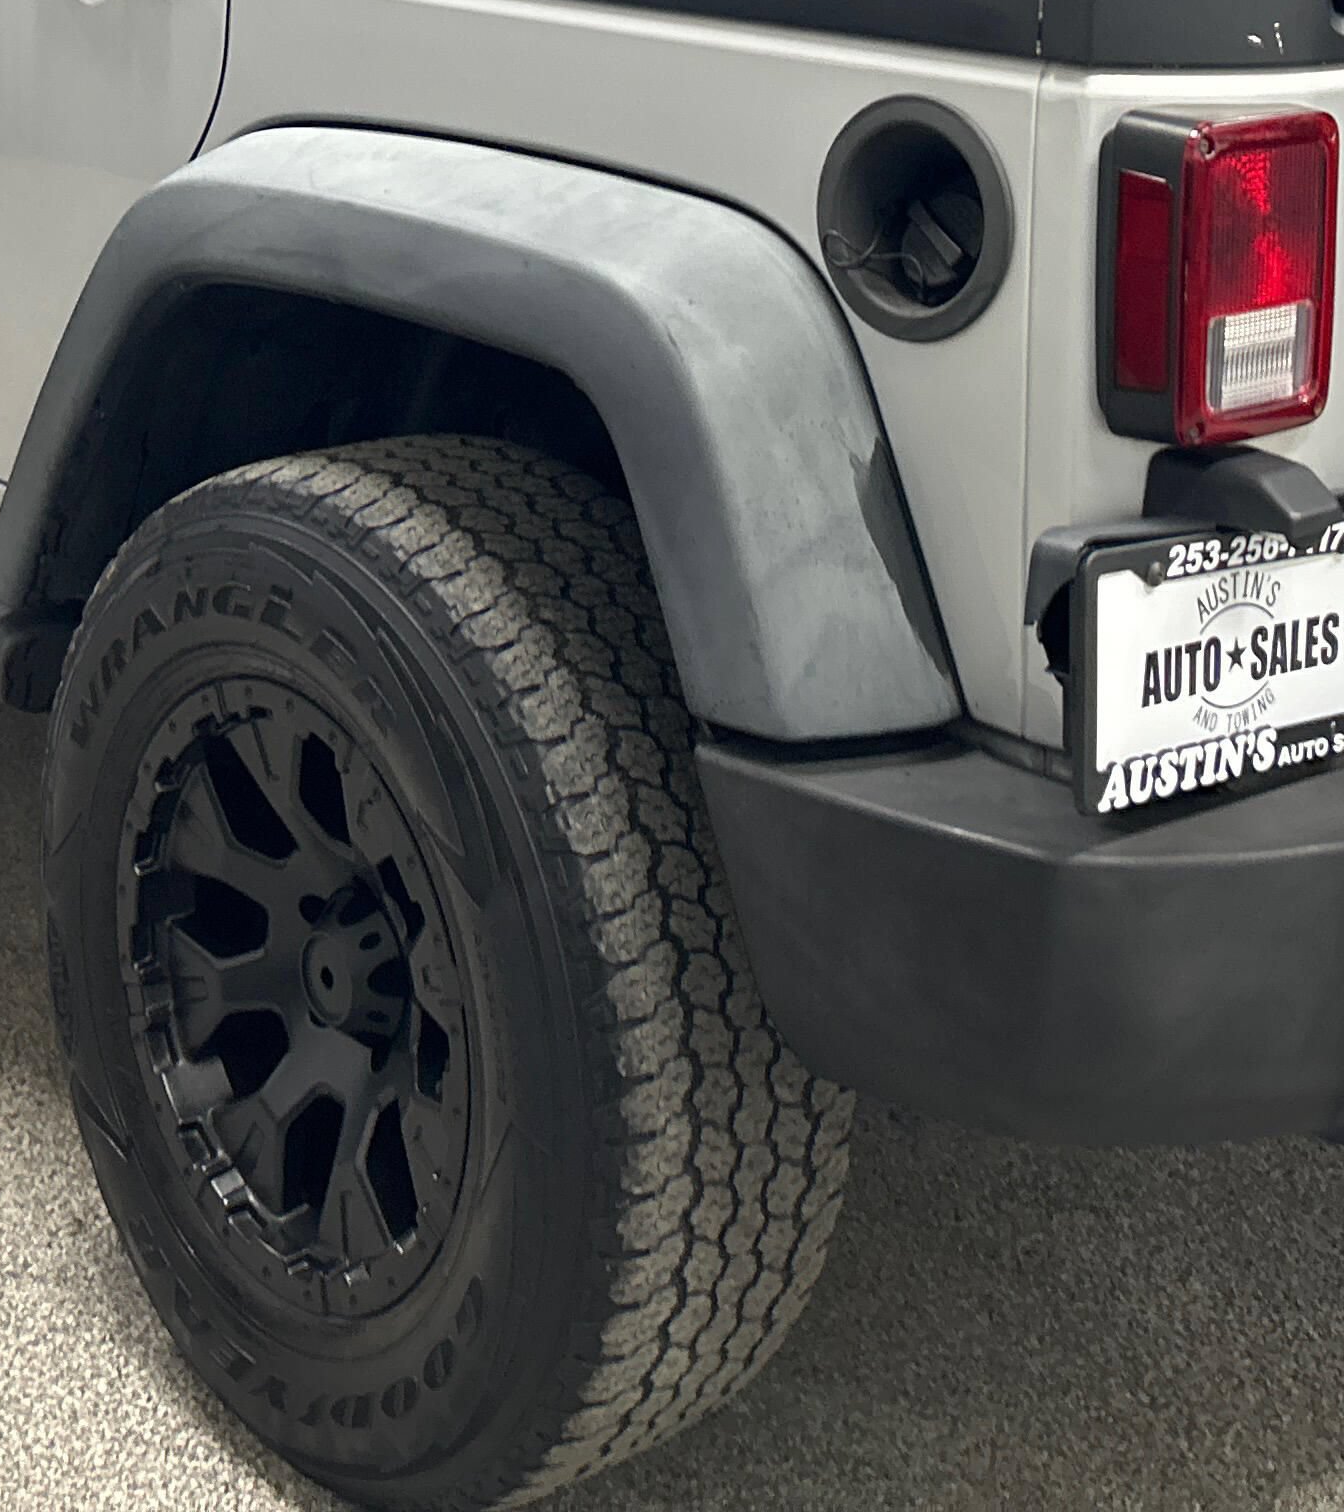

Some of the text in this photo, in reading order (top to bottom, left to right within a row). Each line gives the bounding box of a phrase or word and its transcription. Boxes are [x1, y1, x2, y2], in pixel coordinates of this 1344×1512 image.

[1197, 569, 1281, 623] AUSTIN'S
[1141, 612, 1340, 708] AUTO SALES
[1191, 687, 1276, 734] AND TOWING
[1097, 728, 1280, 813] AUSTIN'S
[1277, 736, 1329, 768] AUTO
